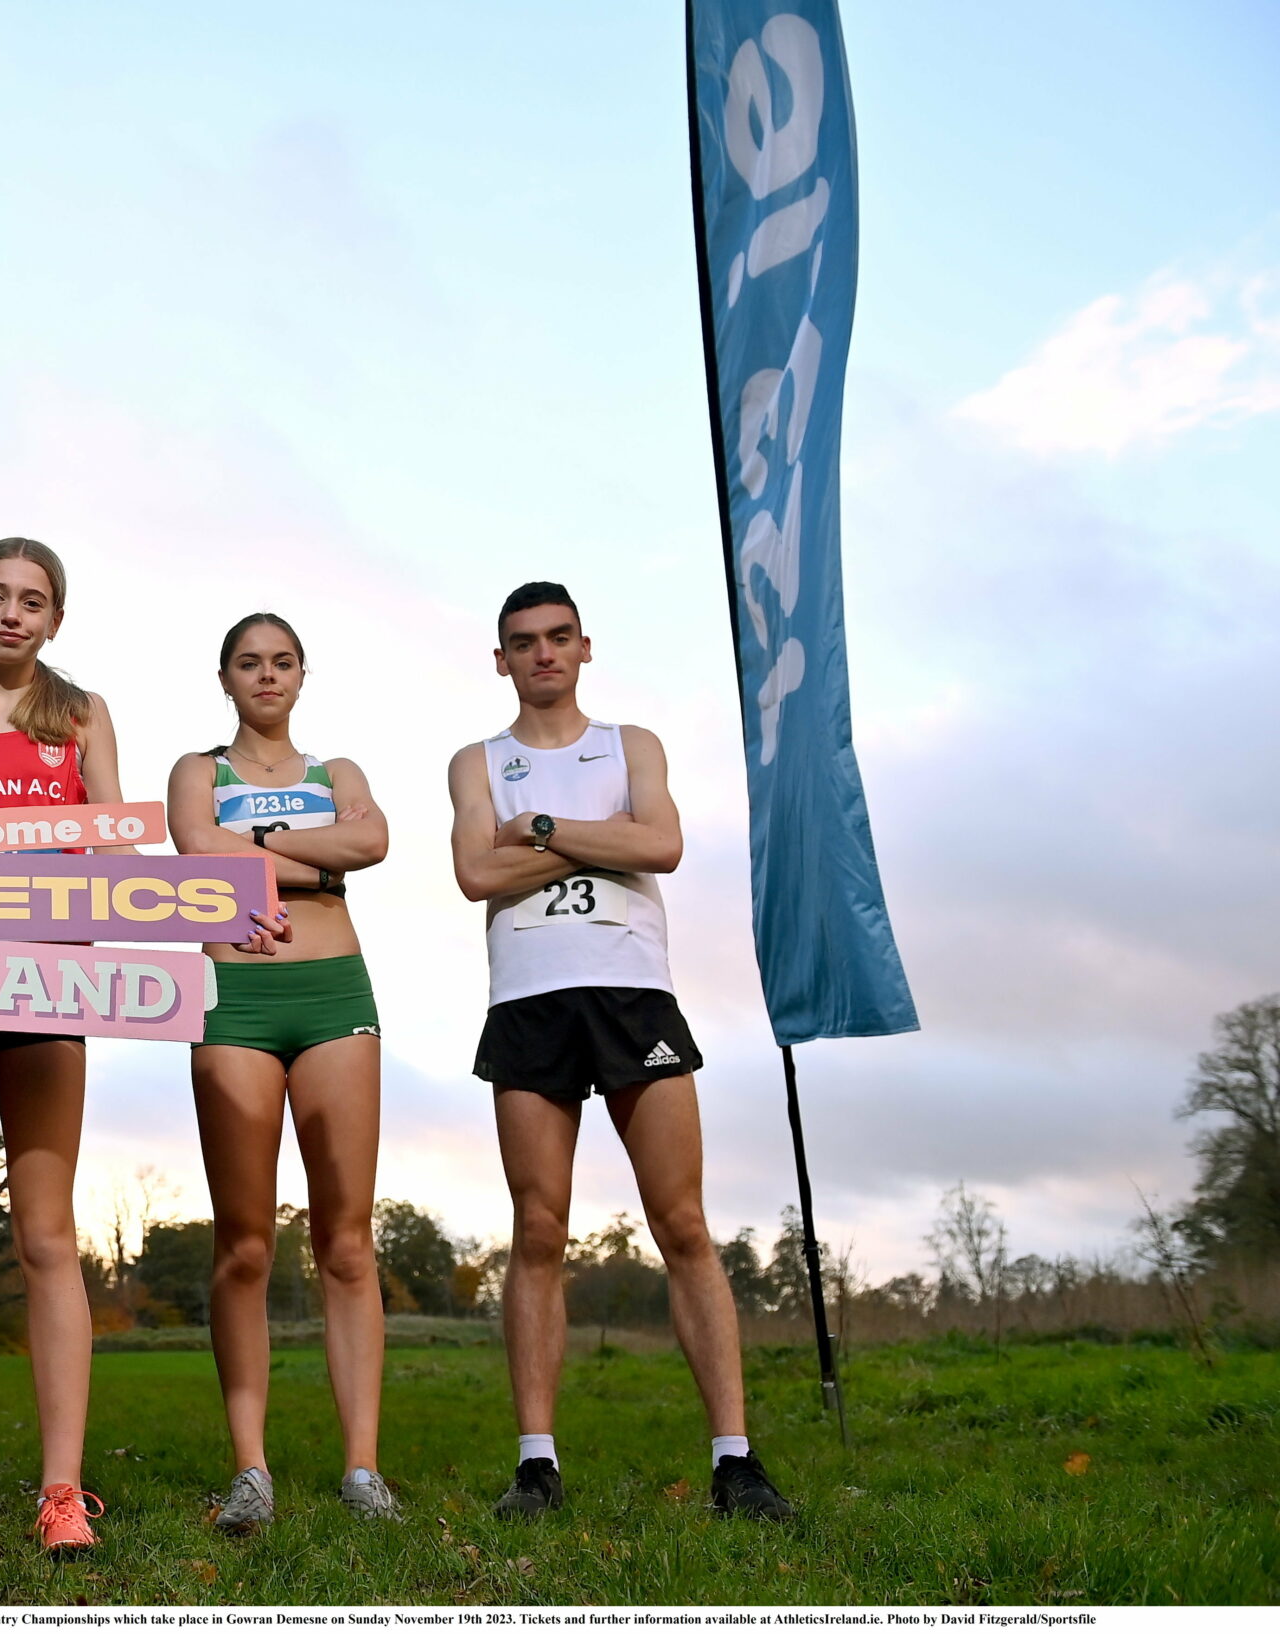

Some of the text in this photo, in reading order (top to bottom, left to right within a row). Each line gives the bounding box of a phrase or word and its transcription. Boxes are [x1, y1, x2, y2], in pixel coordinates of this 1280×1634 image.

[246, 794, 305, 815] 123.ie
[93, 814, 145, 840] to
[544, 879, 596, 916] 23
[644, 1055, 681, 1066] adidas
